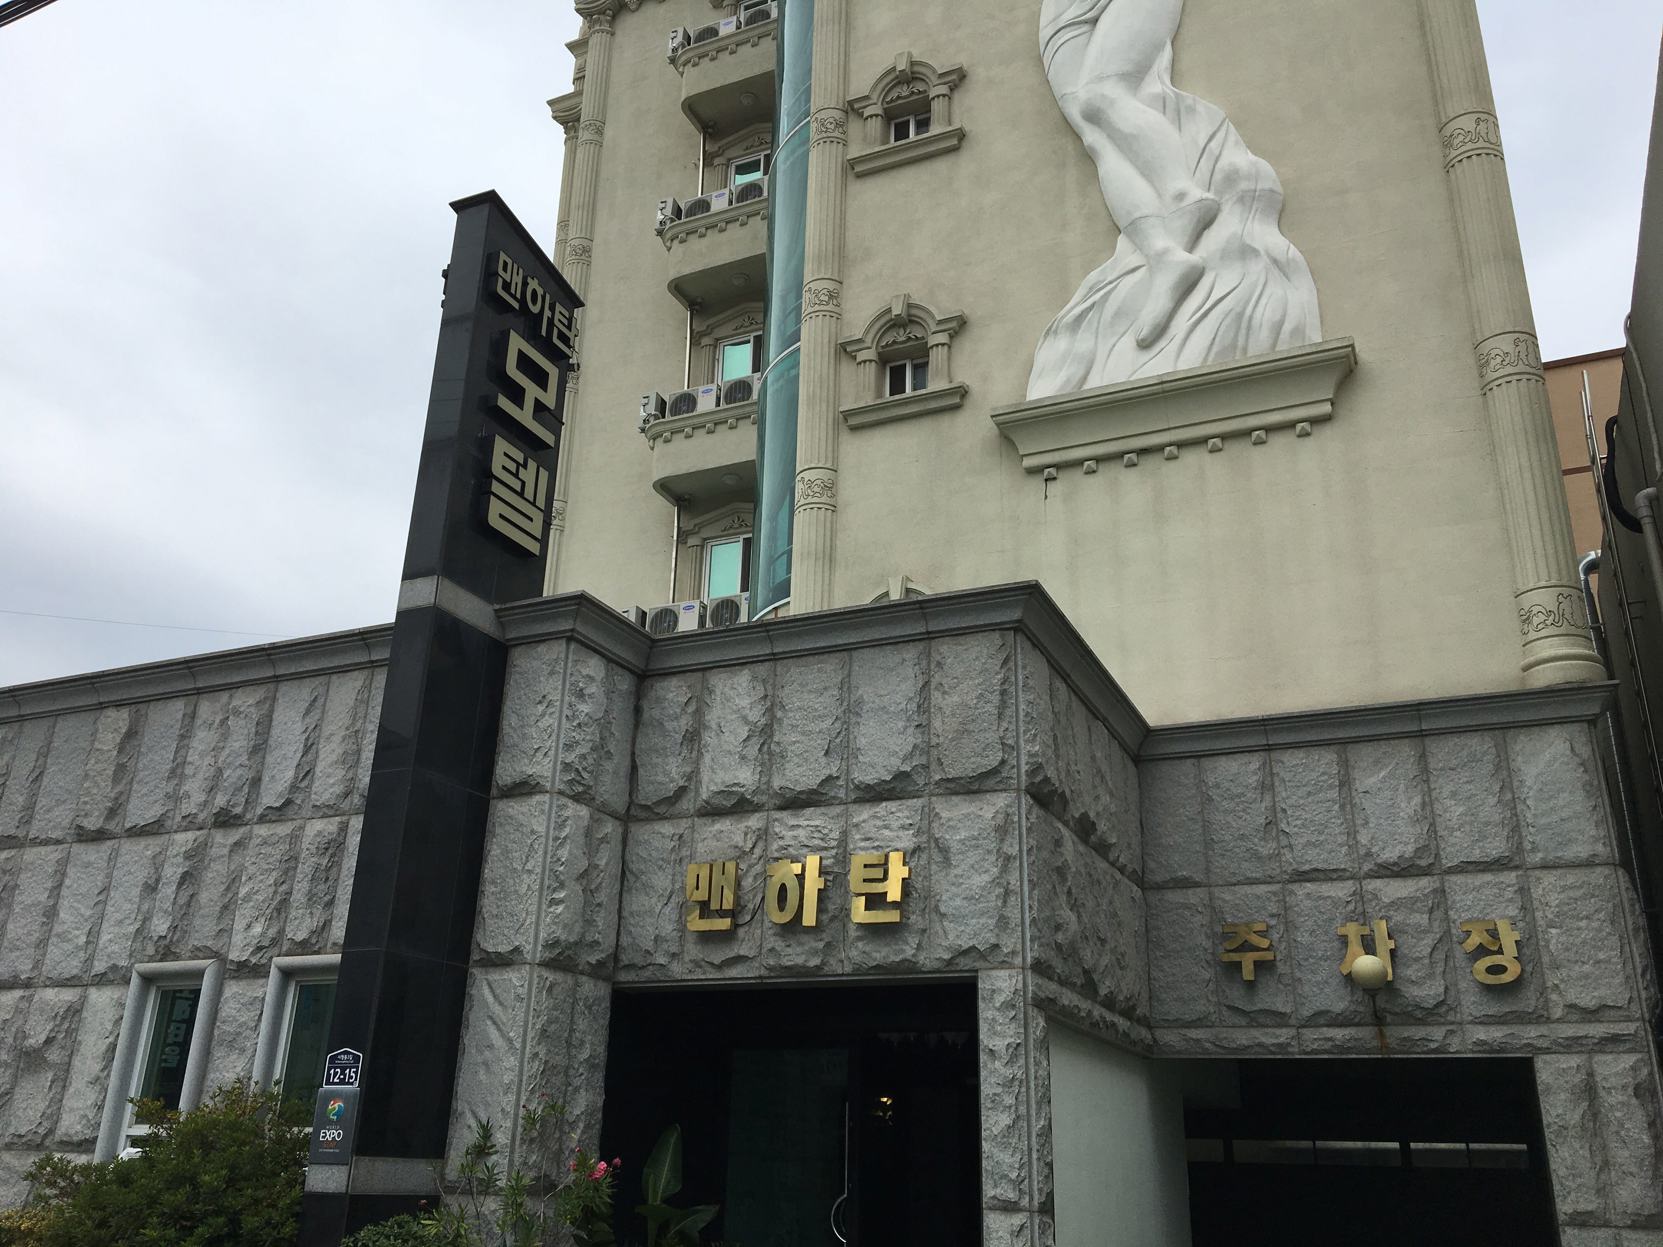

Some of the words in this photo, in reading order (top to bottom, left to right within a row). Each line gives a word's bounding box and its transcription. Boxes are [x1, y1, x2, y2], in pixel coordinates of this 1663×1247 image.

[496, 249, 580, 358] 맨하탄
[487, 328, 560, 557] 모텔
[686, 850, 910, 932] 맨하탄
[1220, 918, 1522, 986] 주차장
[329, 1068, 357, 1083] 12-15
[319, 1129, 343, 1141] EXPO
